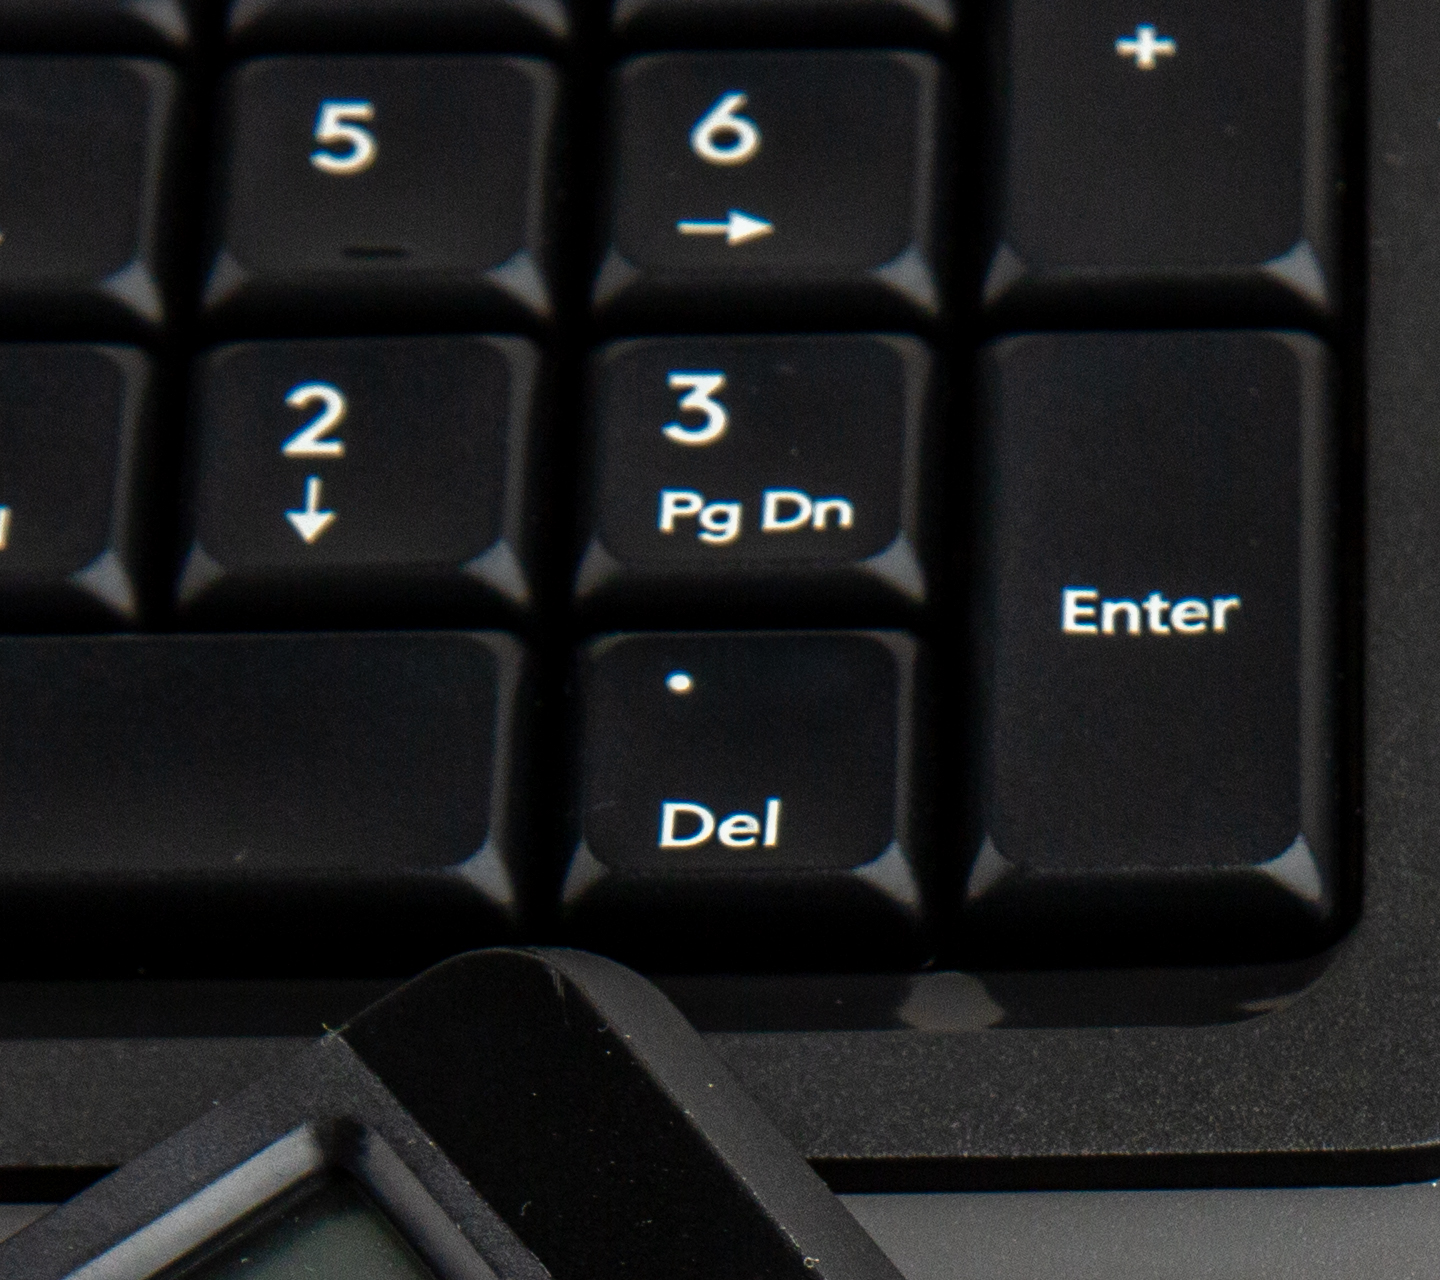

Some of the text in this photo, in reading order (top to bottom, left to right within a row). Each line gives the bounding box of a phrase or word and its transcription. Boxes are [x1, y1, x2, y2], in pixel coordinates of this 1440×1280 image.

[313, 103, 374, 172] 5
[692, 94, 759, 162] 6
[283, 384, 344, 455] 2
[663, 374, 728, 444] 3
[659, 490, 854, 544] Pg Dn
[1062, 589, 1240, 634] Enter
[659, 799, 781, 848] Del
